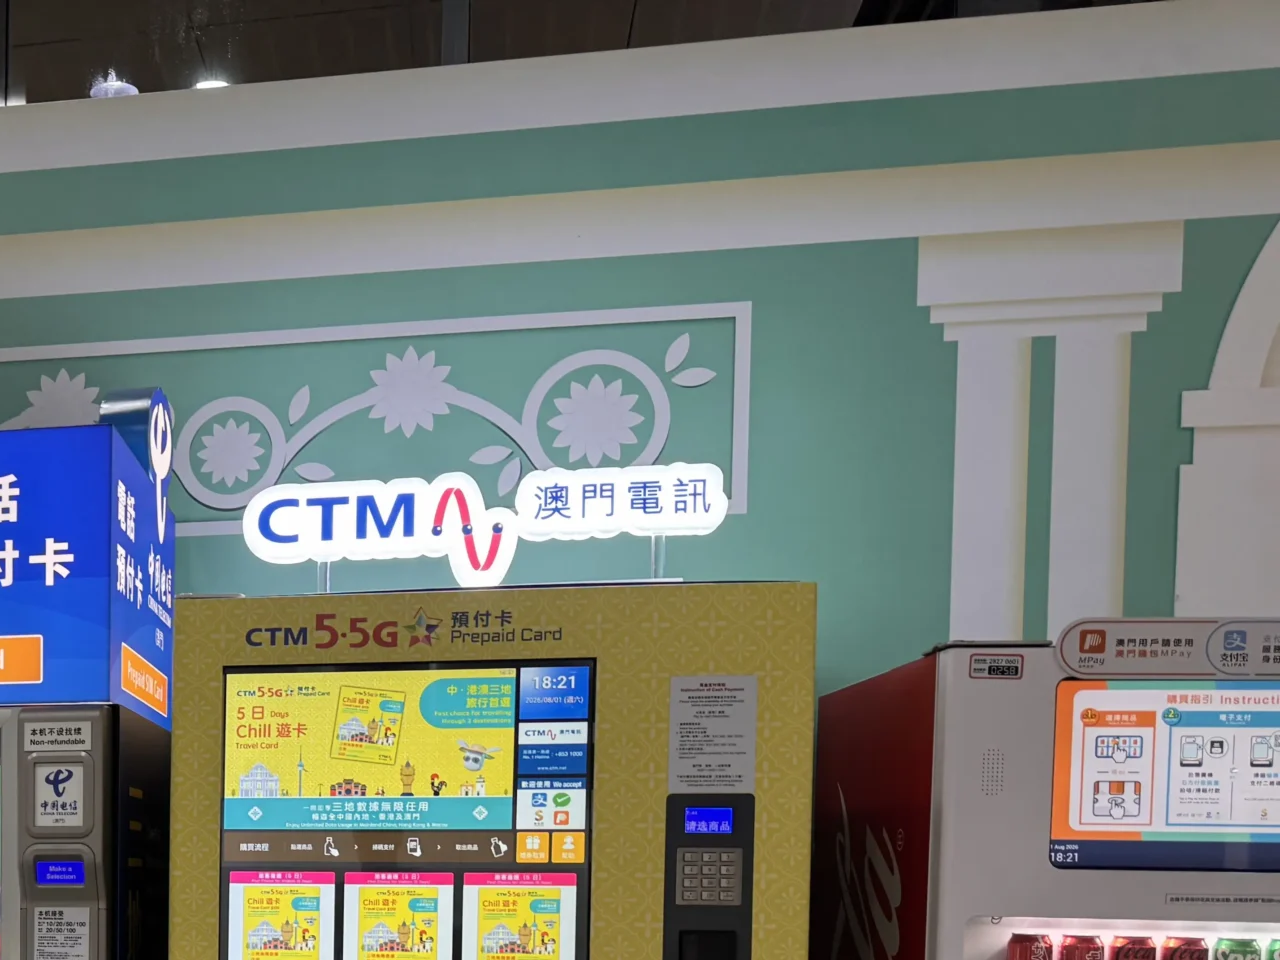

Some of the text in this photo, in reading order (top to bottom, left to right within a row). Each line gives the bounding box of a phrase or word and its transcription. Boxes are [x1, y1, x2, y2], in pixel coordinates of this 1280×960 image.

[117, 479, 136, 543] 電話
[258, 476, 713, 544] CTM 澳門電訊
[116, 543, 144, 610] 預付卡
[450, 610, 513, 628] 預付卡
[245, 626, 308, 647] CTM
[450, 626, 563, 645] Prepaid Card
[1078, 656, 1105, 665] MPay
[1220, 652, 1249, 663] 支付宝
[127, 659, 145, 693] Prepaid
[532, 675, 576, 690] 18:21
[252, 706, 289, 720] 日 Days
[236, 722, 308, 738] Chill 遊卡
[524, 729, 546, 737] CTM
[29, 738, 86, 746] Non-refundable
[40, 800, 78, 812] 中国电信
[1050, 852, 1079, 863] 18:21
